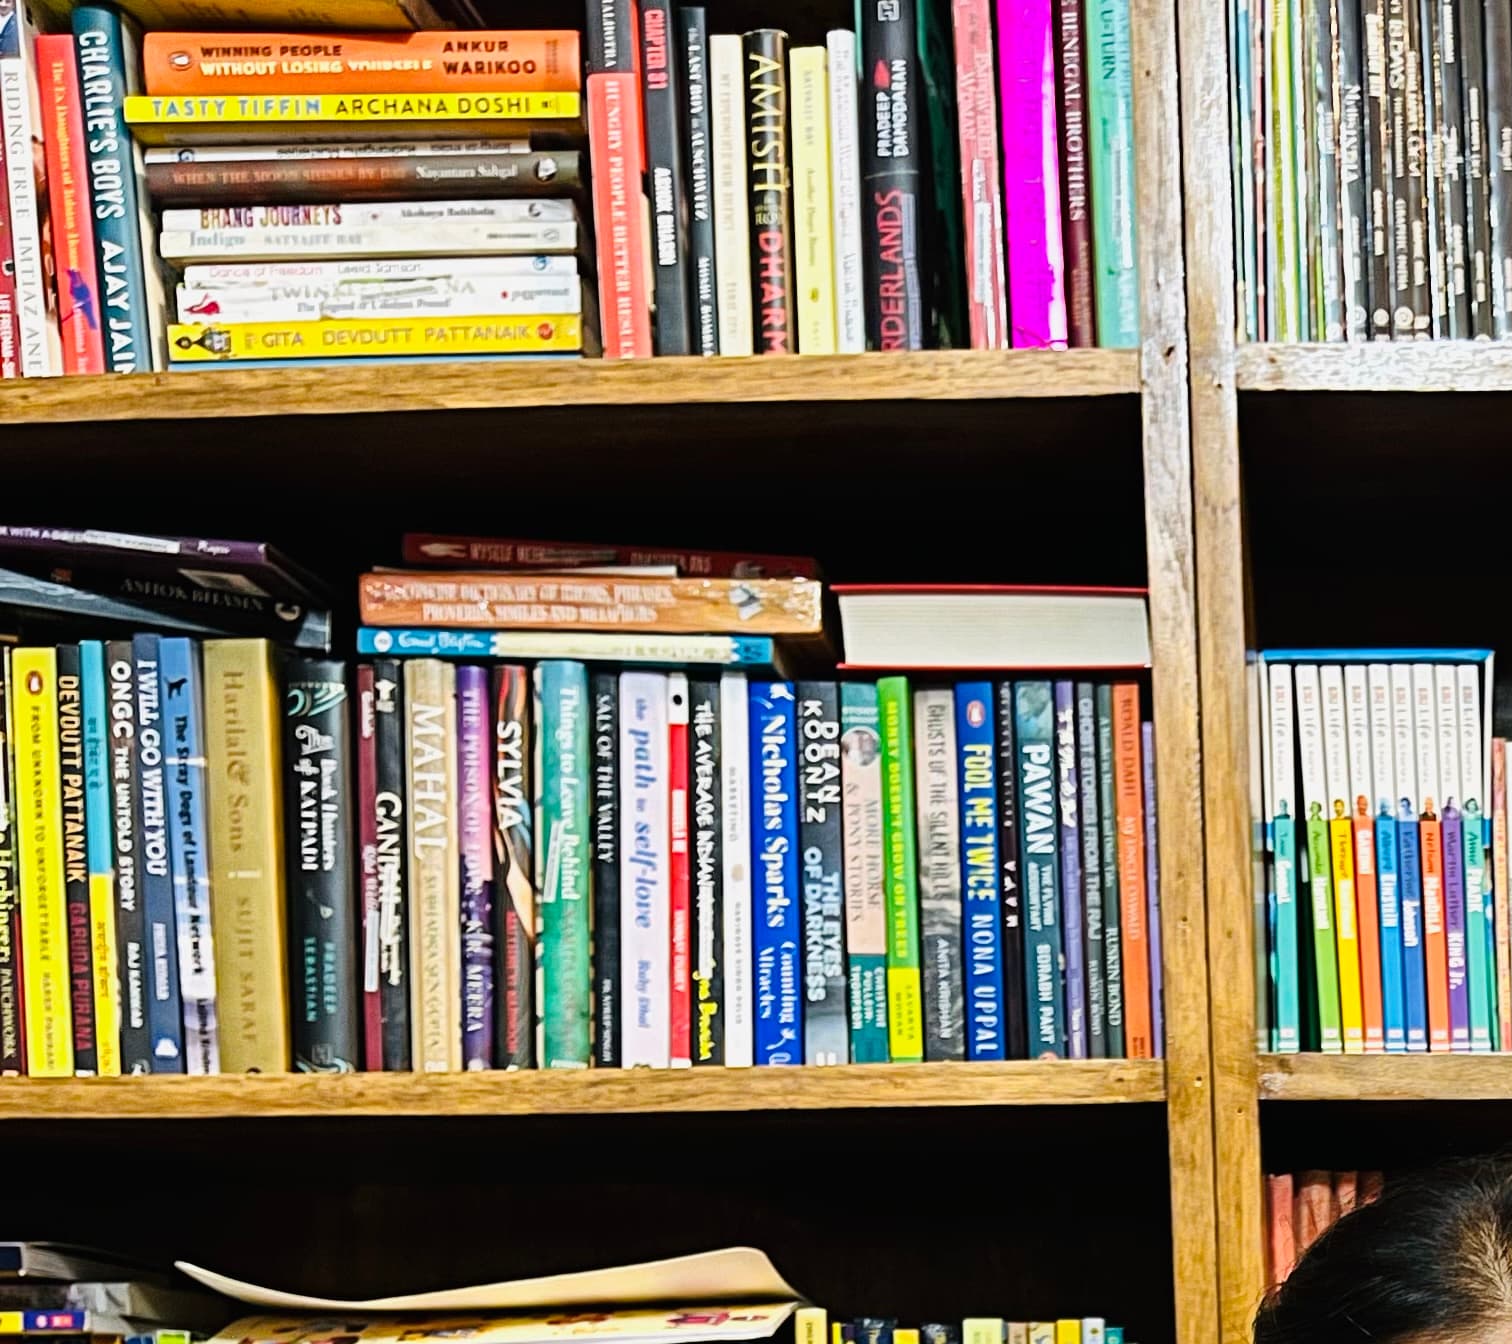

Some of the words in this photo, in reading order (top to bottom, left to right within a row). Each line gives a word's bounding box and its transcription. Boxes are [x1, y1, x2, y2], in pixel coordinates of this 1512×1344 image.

[443, 40, 509, 53] ANKUR
[443, 60, 536, 76] WARIKOO
[78, 31, 111, 162] CHARLIE'S
[153, 100, 224, 117] TASTY
[239, 98, 321, 116] TIFFIN
[335, 97, 449, 115] ARCHANA
[458, 97, 531, 114] DOSHI
[748, 53, 787, 193] AMISH
[92, 167, 124, 219] BOYS
[411, 702, 448, 860] MAHAL
[497, 721, 524, 831] SYLVIA
[761, 714, 788, 829] Nicholas
[963, 744, 992, 792] FOOL
[1022, 744, 1054, 854] PAWAN
[965, 798, 994, 826] ME
[760, 837, 789, 927] Sparks
[966, 832, 995, 901] TWICE
[972, 914, 994, 975] NONA
[973, 987, 998, 1054] UPPAL
